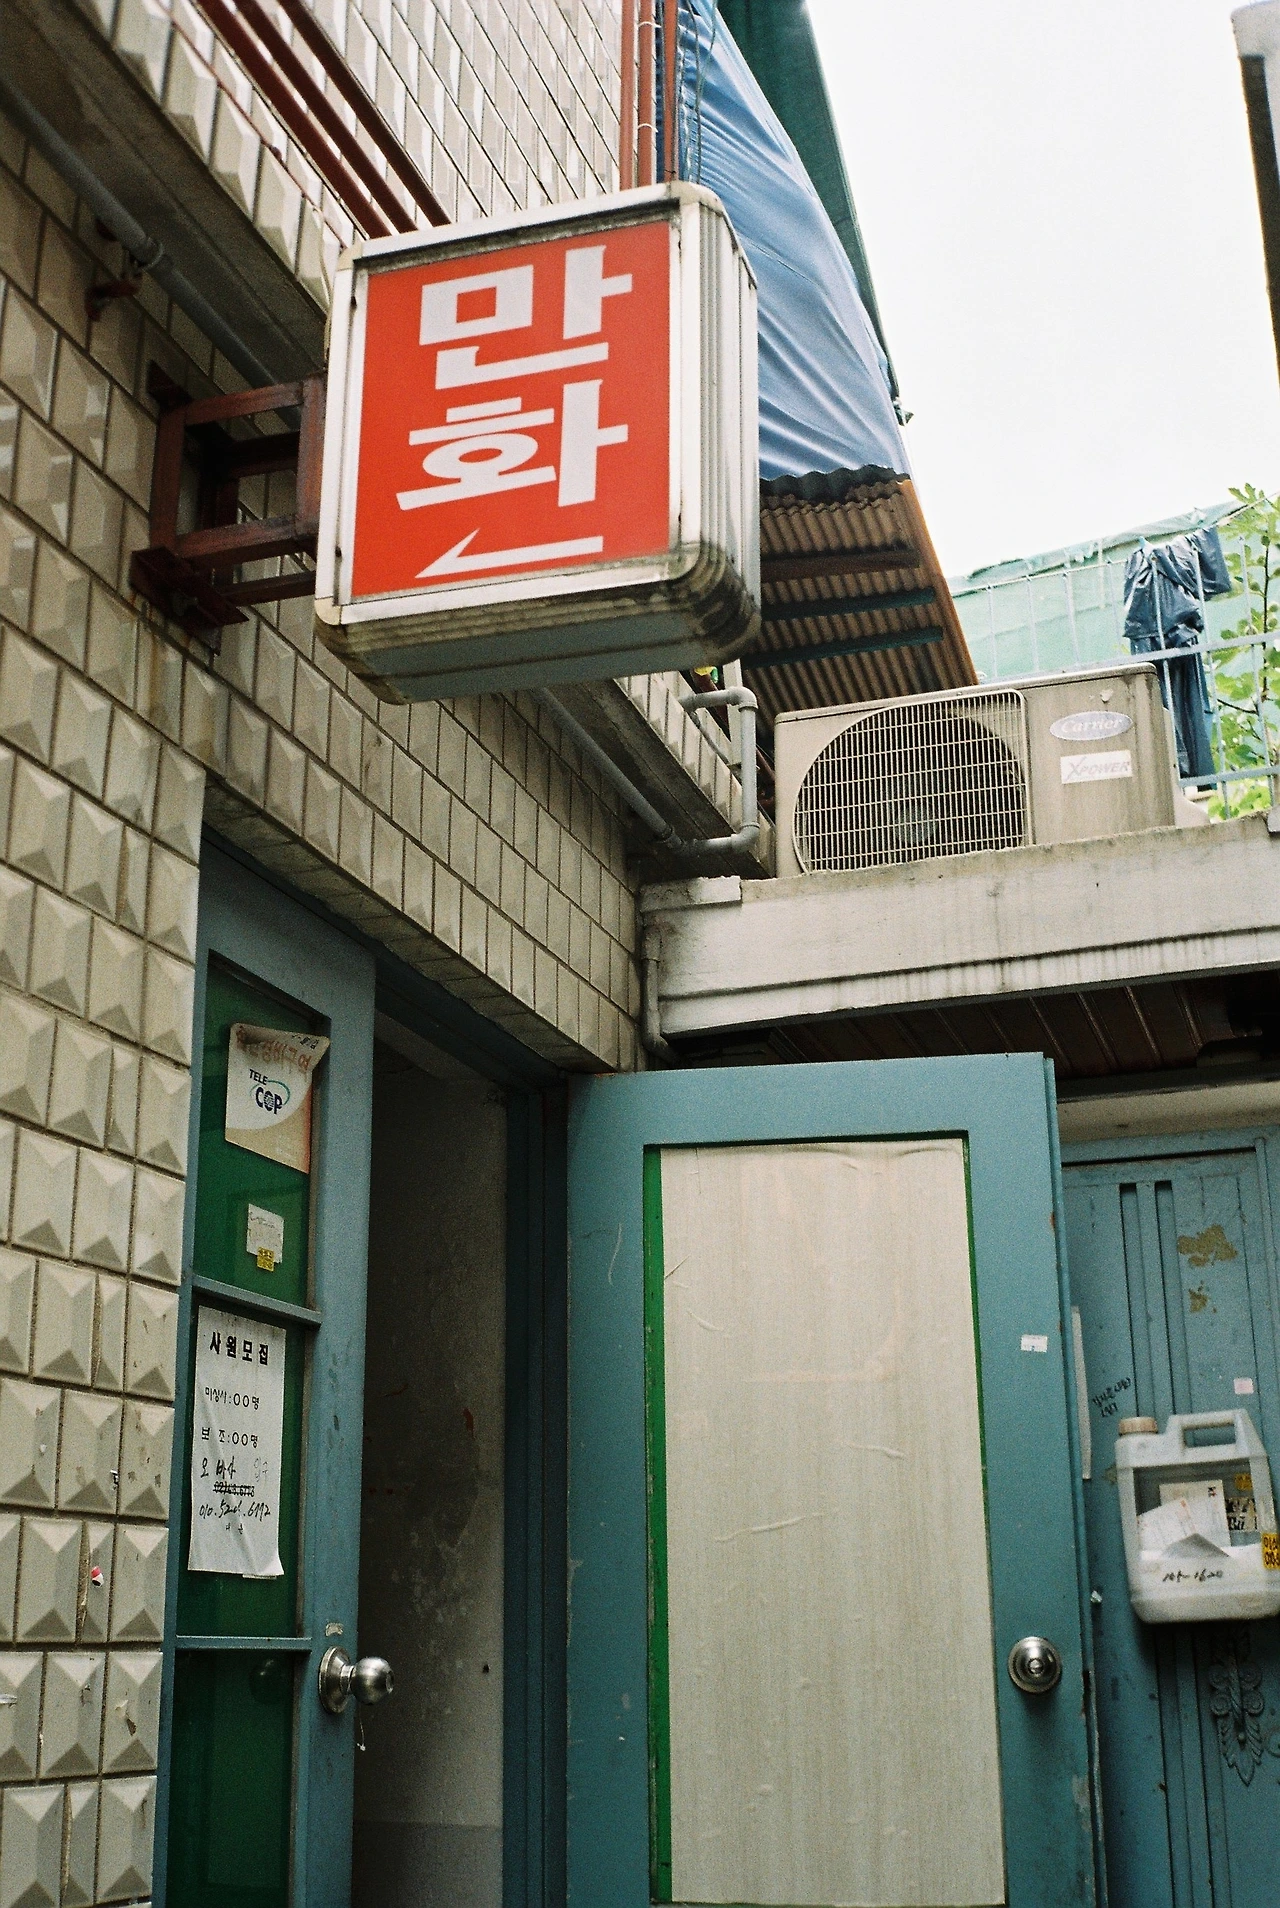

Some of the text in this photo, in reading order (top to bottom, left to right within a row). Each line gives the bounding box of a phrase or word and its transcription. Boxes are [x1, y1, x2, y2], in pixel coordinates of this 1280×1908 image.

[396, 245, 633, 511] 만화
[1061, 719, 1123, 733] Carrier
[249, 1068, 268, 1086] TELE
[255, 1086, 283, 1115] COP
[209, 1331, 269, 1366] 사원모집
